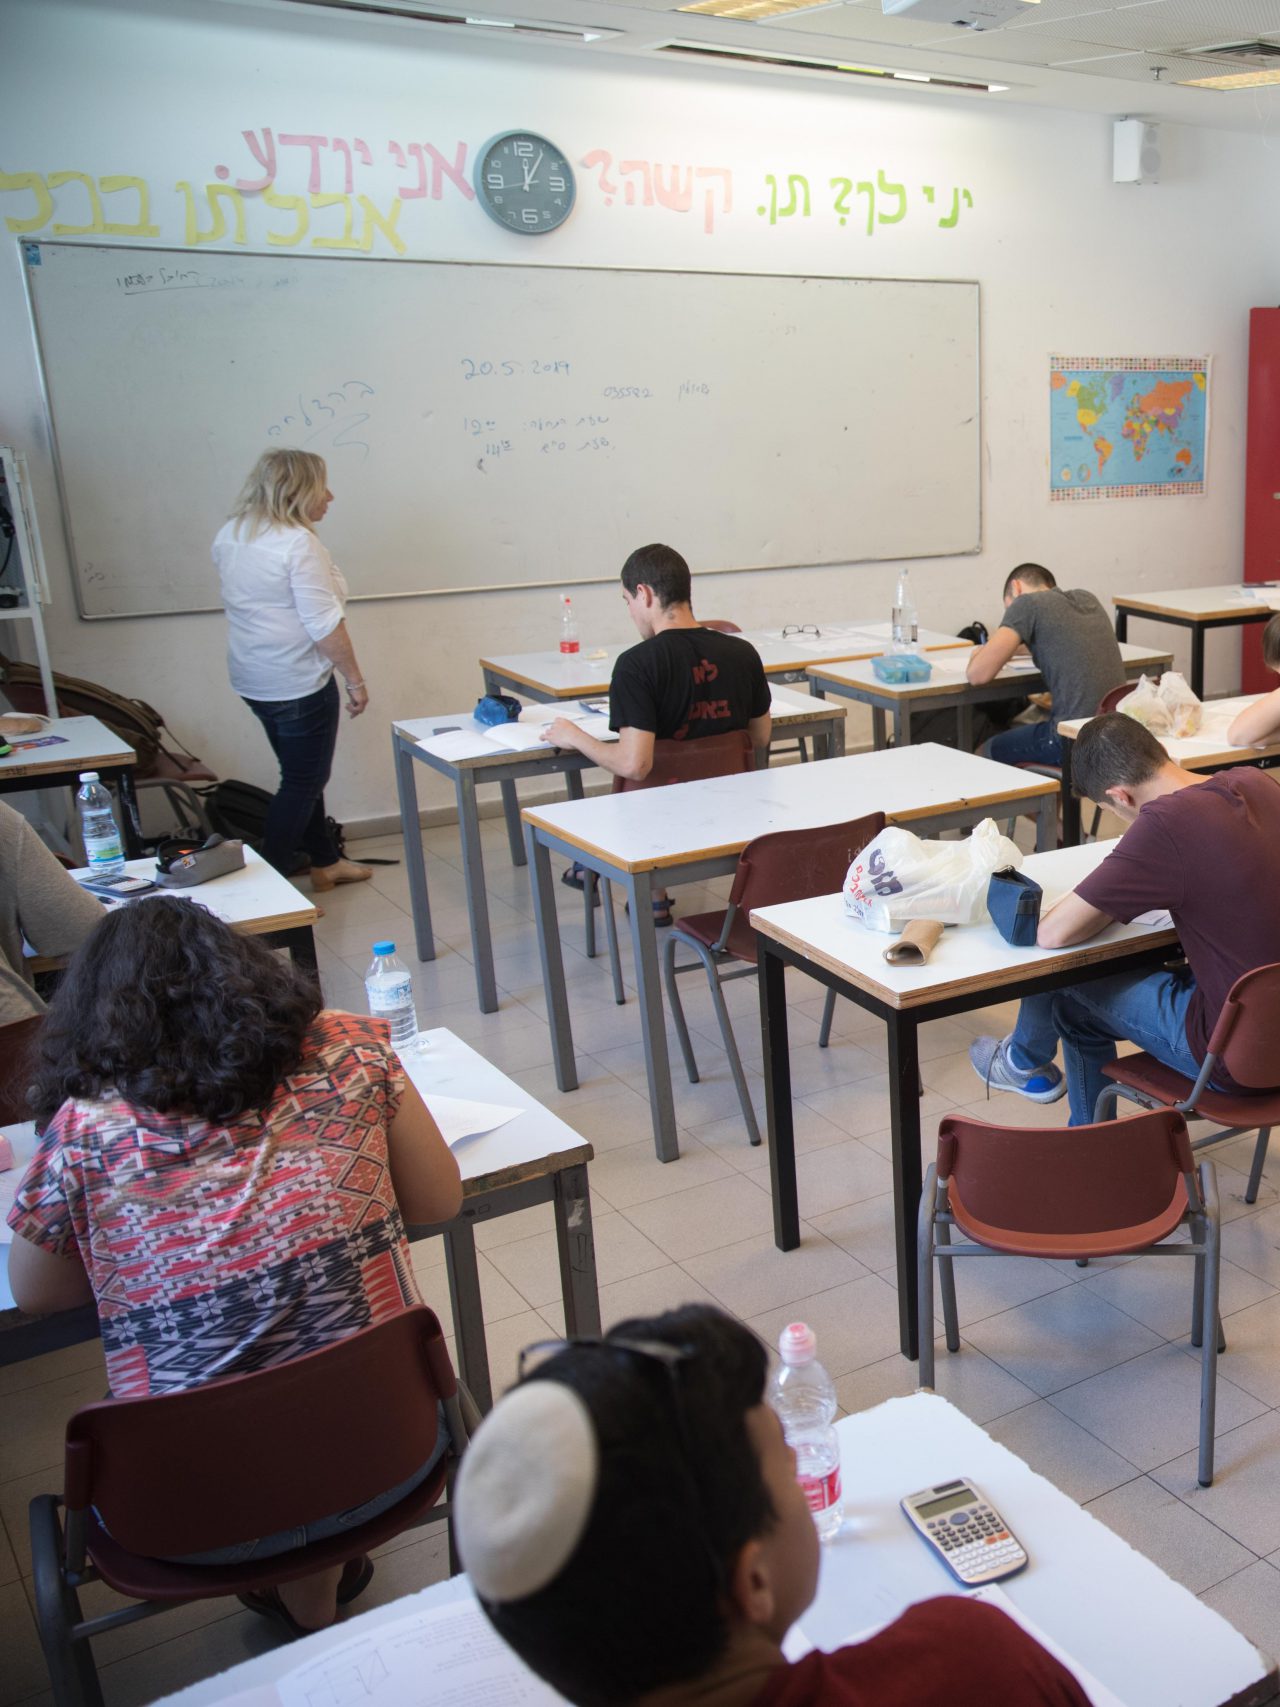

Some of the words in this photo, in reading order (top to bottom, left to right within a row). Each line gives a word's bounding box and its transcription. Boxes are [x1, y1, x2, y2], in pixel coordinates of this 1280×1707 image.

[214, 127, 373, 194] יודע.
[387, 140, 477, 200] אני
[513, 142, 534, 157] 12
[487, 173, 504, 189] 9
[549, 176, 565, 192] 3
[582, 149, 732, 234] קשה?
[757, 174, 810, 225] תן.
[830, 170, 907, 236] לך?
[264, 188, 407, 254] אבל
[522, 208, 537, 224] 6
